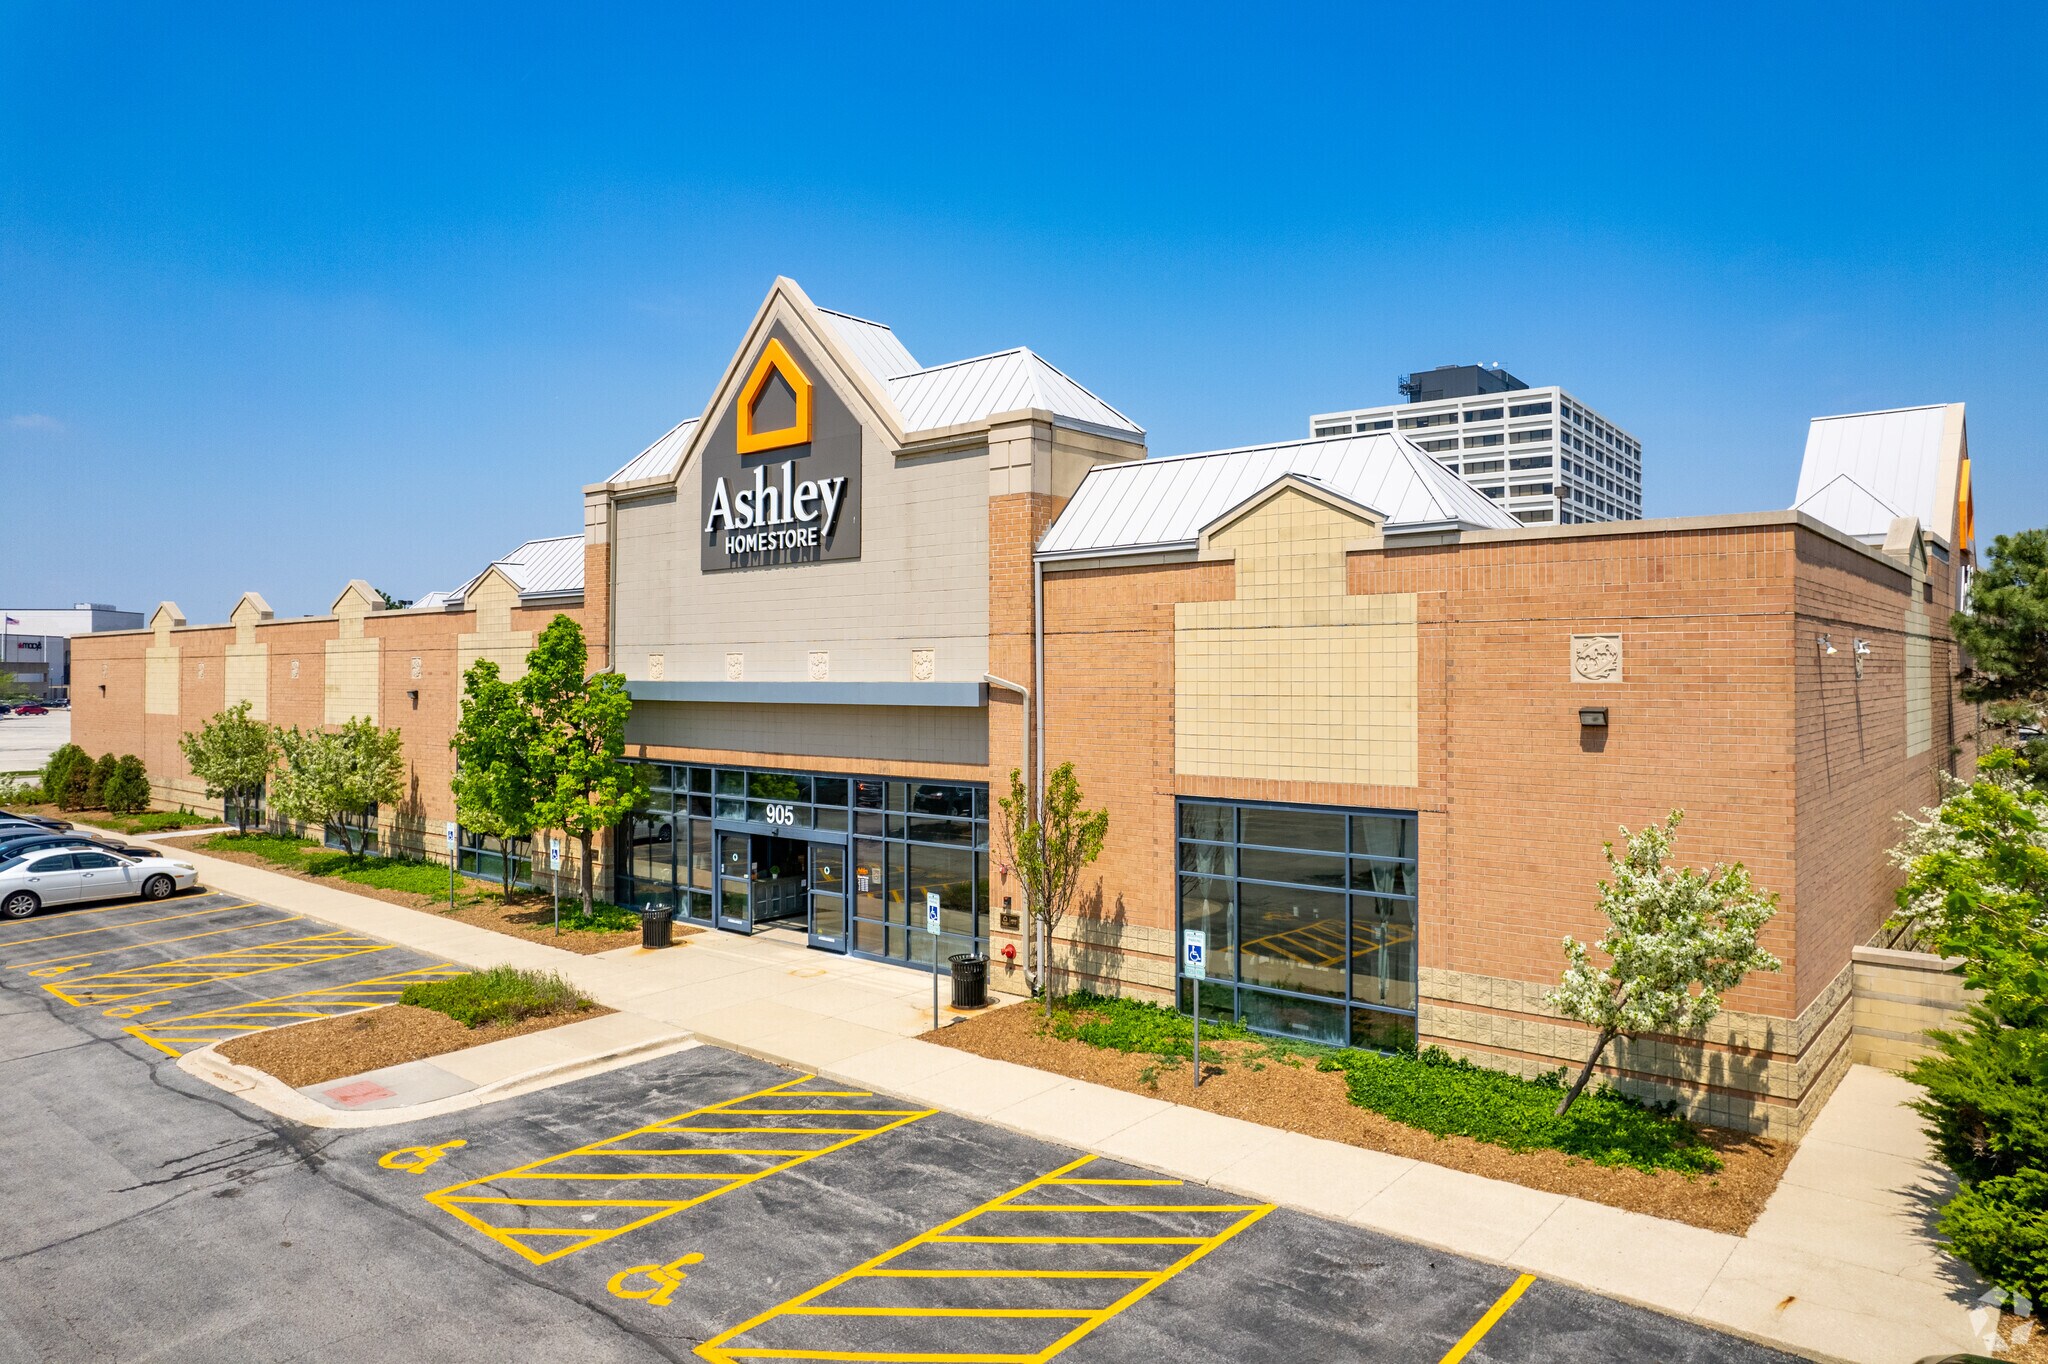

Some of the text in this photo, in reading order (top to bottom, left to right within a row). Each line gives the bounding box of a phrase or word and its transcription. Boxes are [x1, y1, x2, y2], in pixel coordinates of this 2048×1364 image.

[704, 459, 847, 537] Ashley
[724, 526, 819, 555] HOMESTORE
[766, 803, 794, 826] 905
